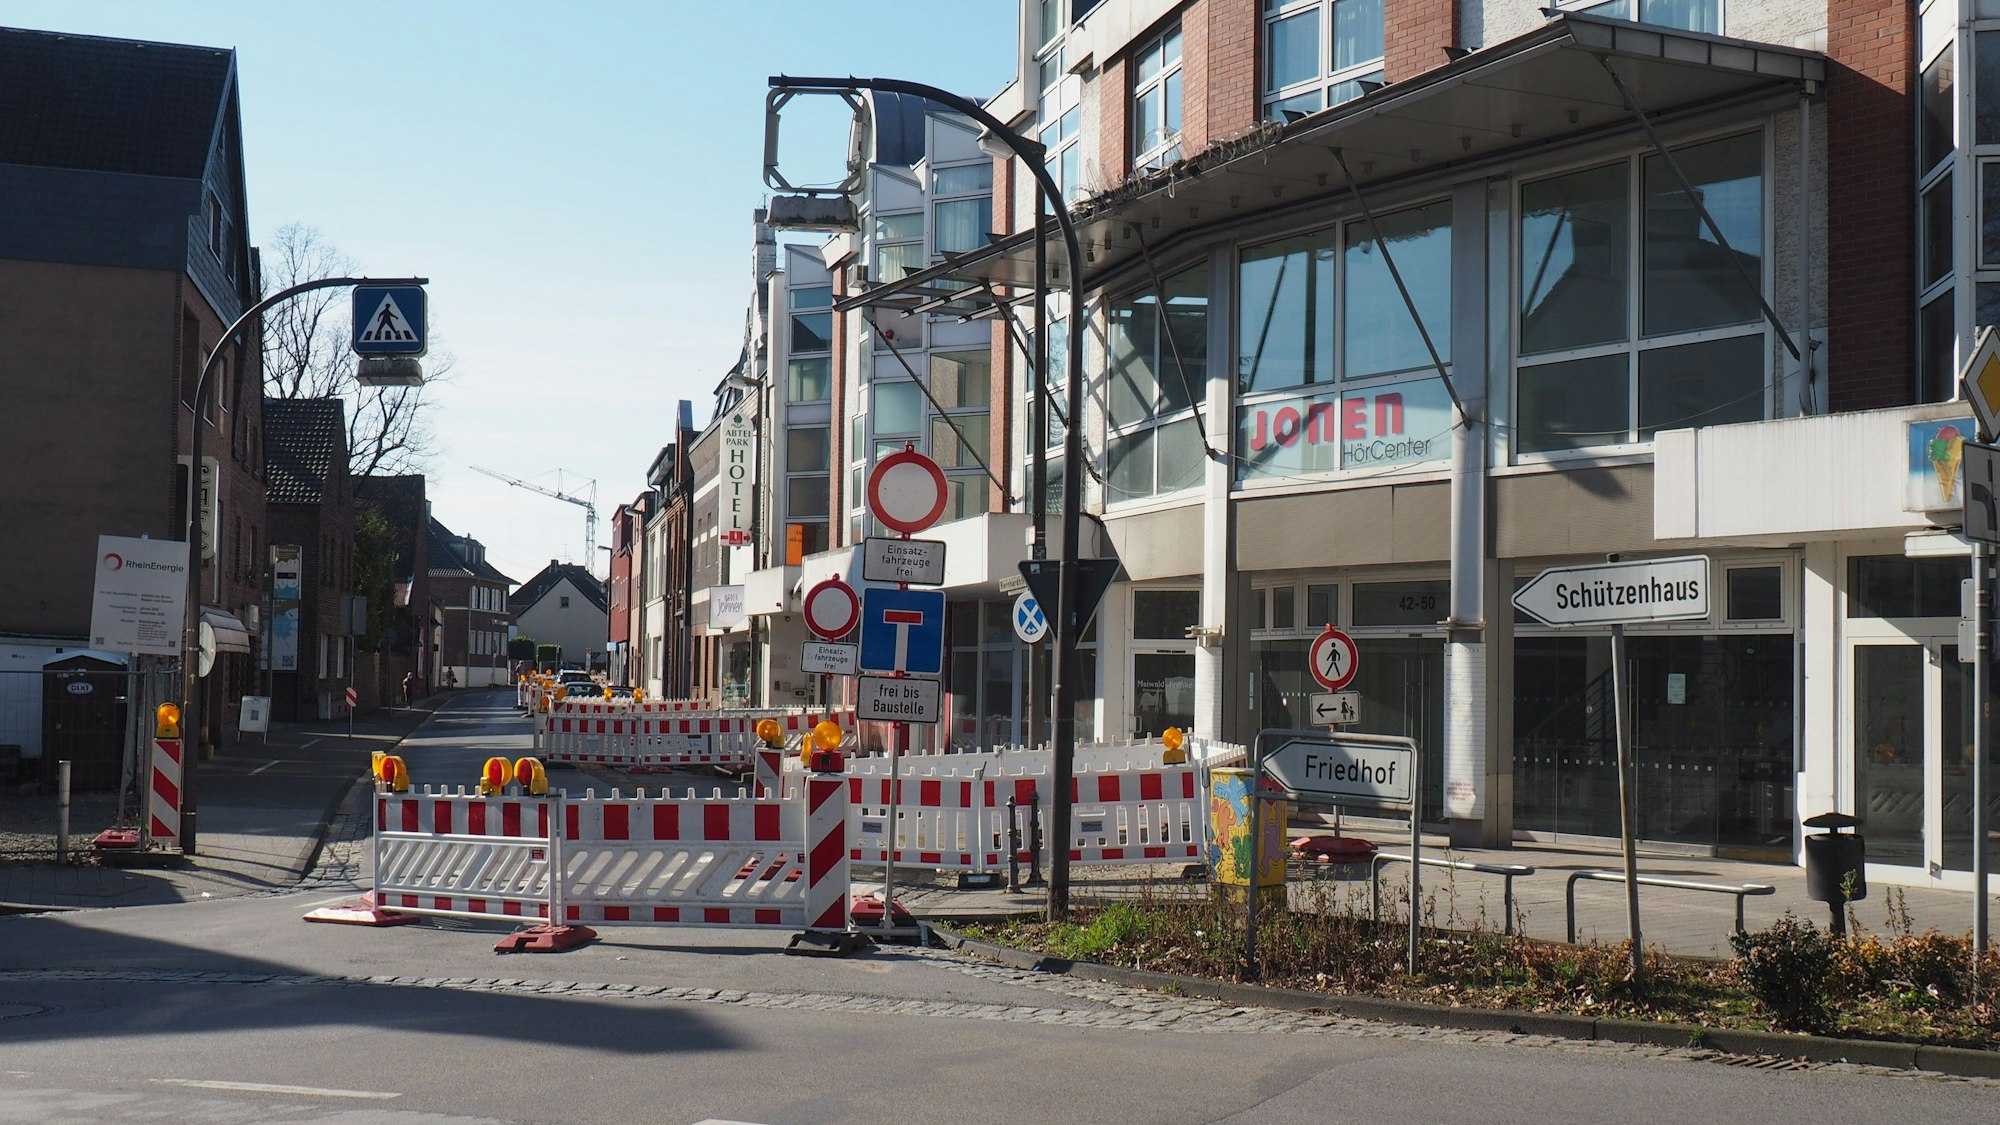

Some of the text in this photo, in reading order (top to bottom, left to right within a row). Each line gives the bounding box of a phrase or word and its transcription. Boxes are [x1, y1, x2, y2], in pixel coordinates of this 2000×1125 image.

[725, 429, 751, 438] ABTEI
[726, 438, 749, 446] PARK
[1343, 437, 1431, 463] HörCenter
[729, 449, 745, 529] HOTEL
[887, 545, 927, 556] Einsatz-
[125, 560, 184, 573] RheinEnergie
[882, 555, 930, 568] fahrzeuge
[896, 567, 913, 576] frei
[1556, 576, 1699, 609] Schützenhaus
[1399, 596, 1435, 610] 42-50
[818, 646, 847, 655] Einsatz-
[814, 654, 848, 664] fahrzeuge
[824, 662, 836, 670] frei
[879, 683, 920, 699] frei bis
[873, 699, 924, 714] Baustelle
[1305, 754, 1396, 785] Friedhof
